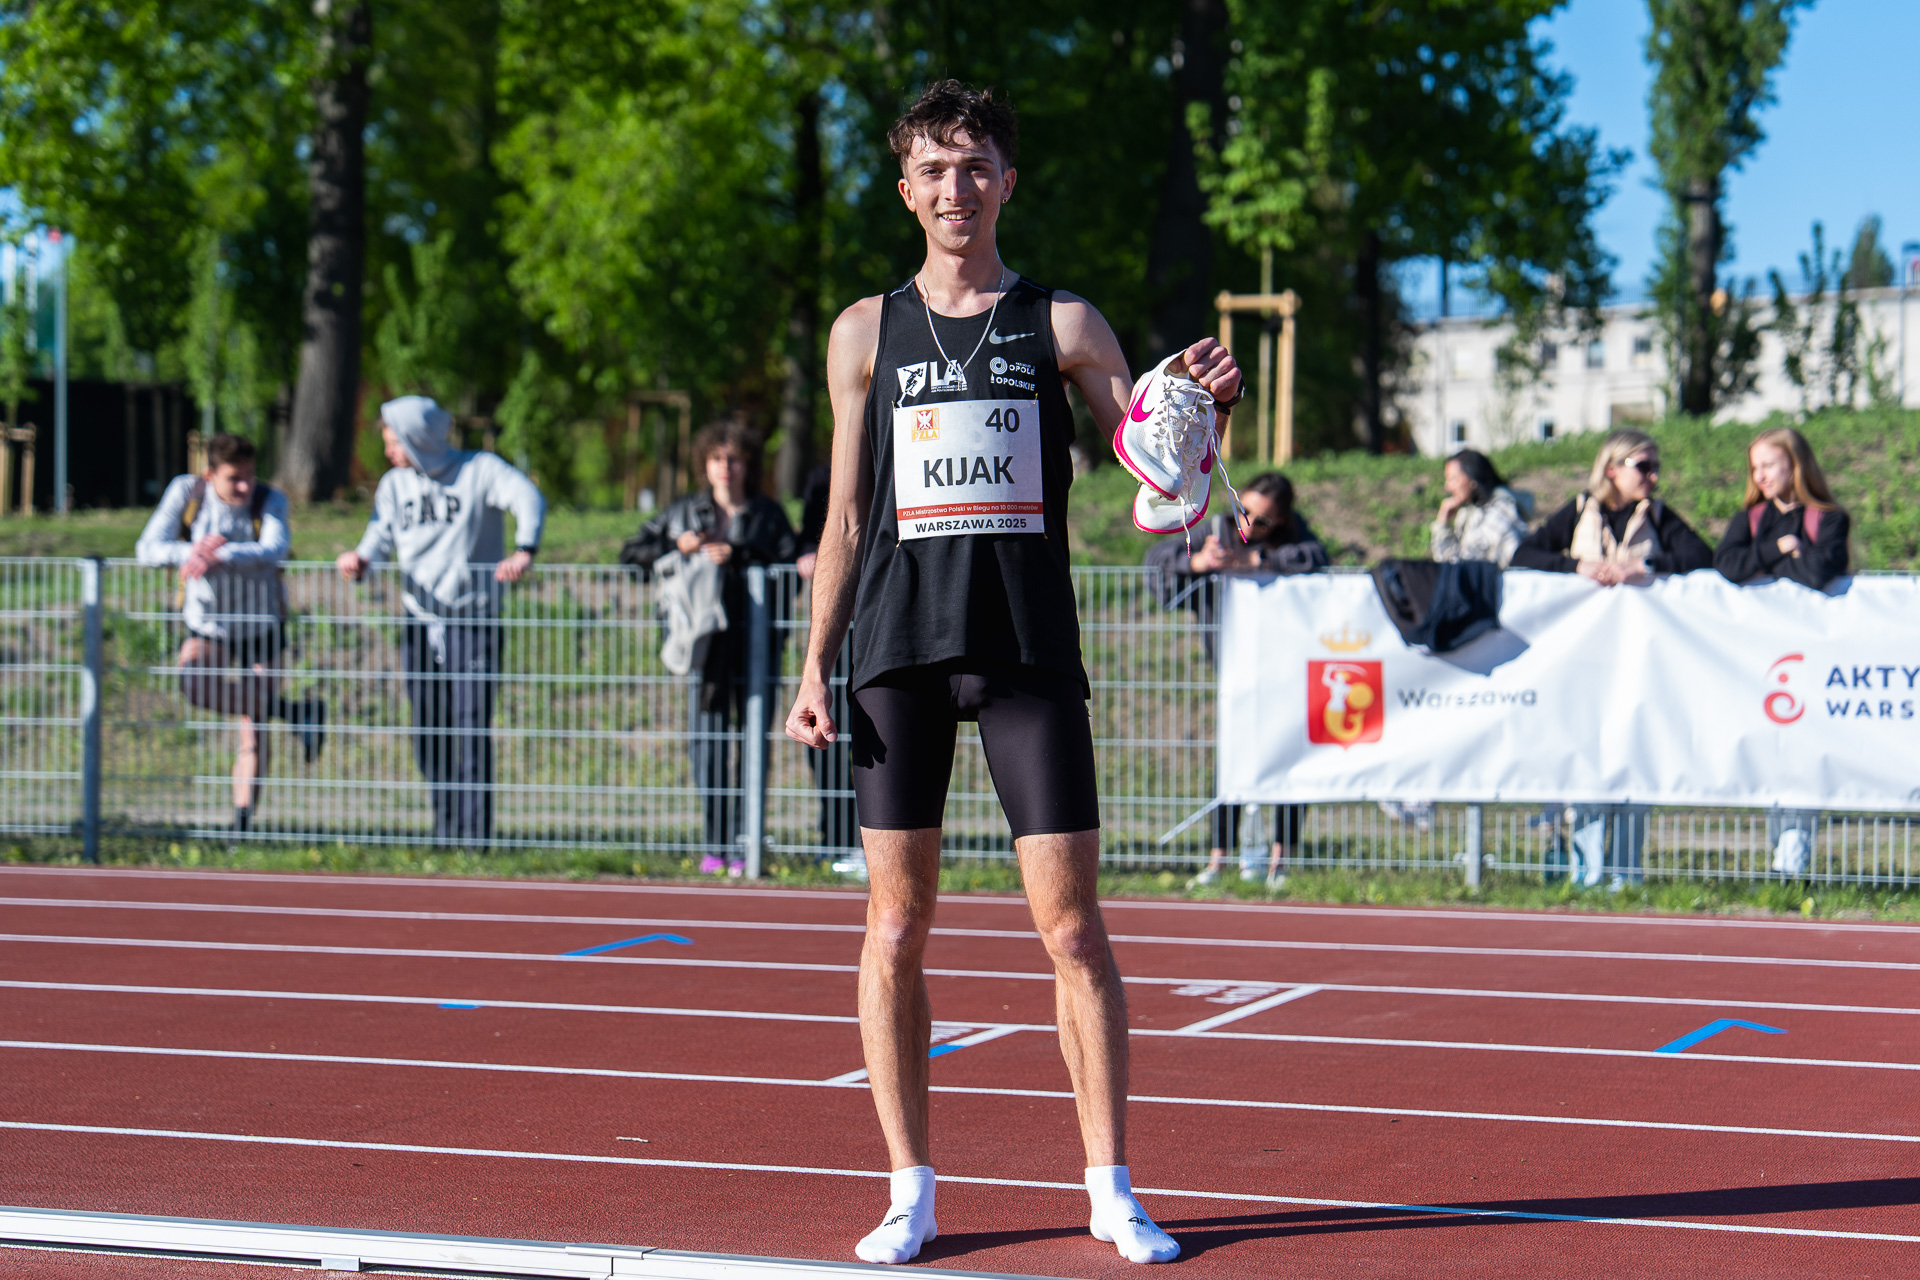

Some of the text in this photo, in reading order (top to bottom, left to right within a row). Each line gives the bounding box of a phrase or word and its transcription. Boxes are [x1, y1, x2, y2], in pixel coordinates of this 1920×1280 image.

[1008, 364, 1036, 376] OPOLE
[995, 376, 1036, 392] OPOLSKIE
[985, 407, 1021, 433] 40
[913, 429, 938, 441] PZLA
[923, 455, 1016, 488] KIJAK
[402, 494, 461, 531] GAP
[915, 507, 948, 516] Mistrzostwa
[949, 505, 966, 513] Polski
[915, 518, 1027, 533] WARSZAWA 2025
[1826, 665, 1920, 689] AKTY
[1397, 687, 1538, 709] Warszawa
[1826, 699, 1915, 719] WARS
